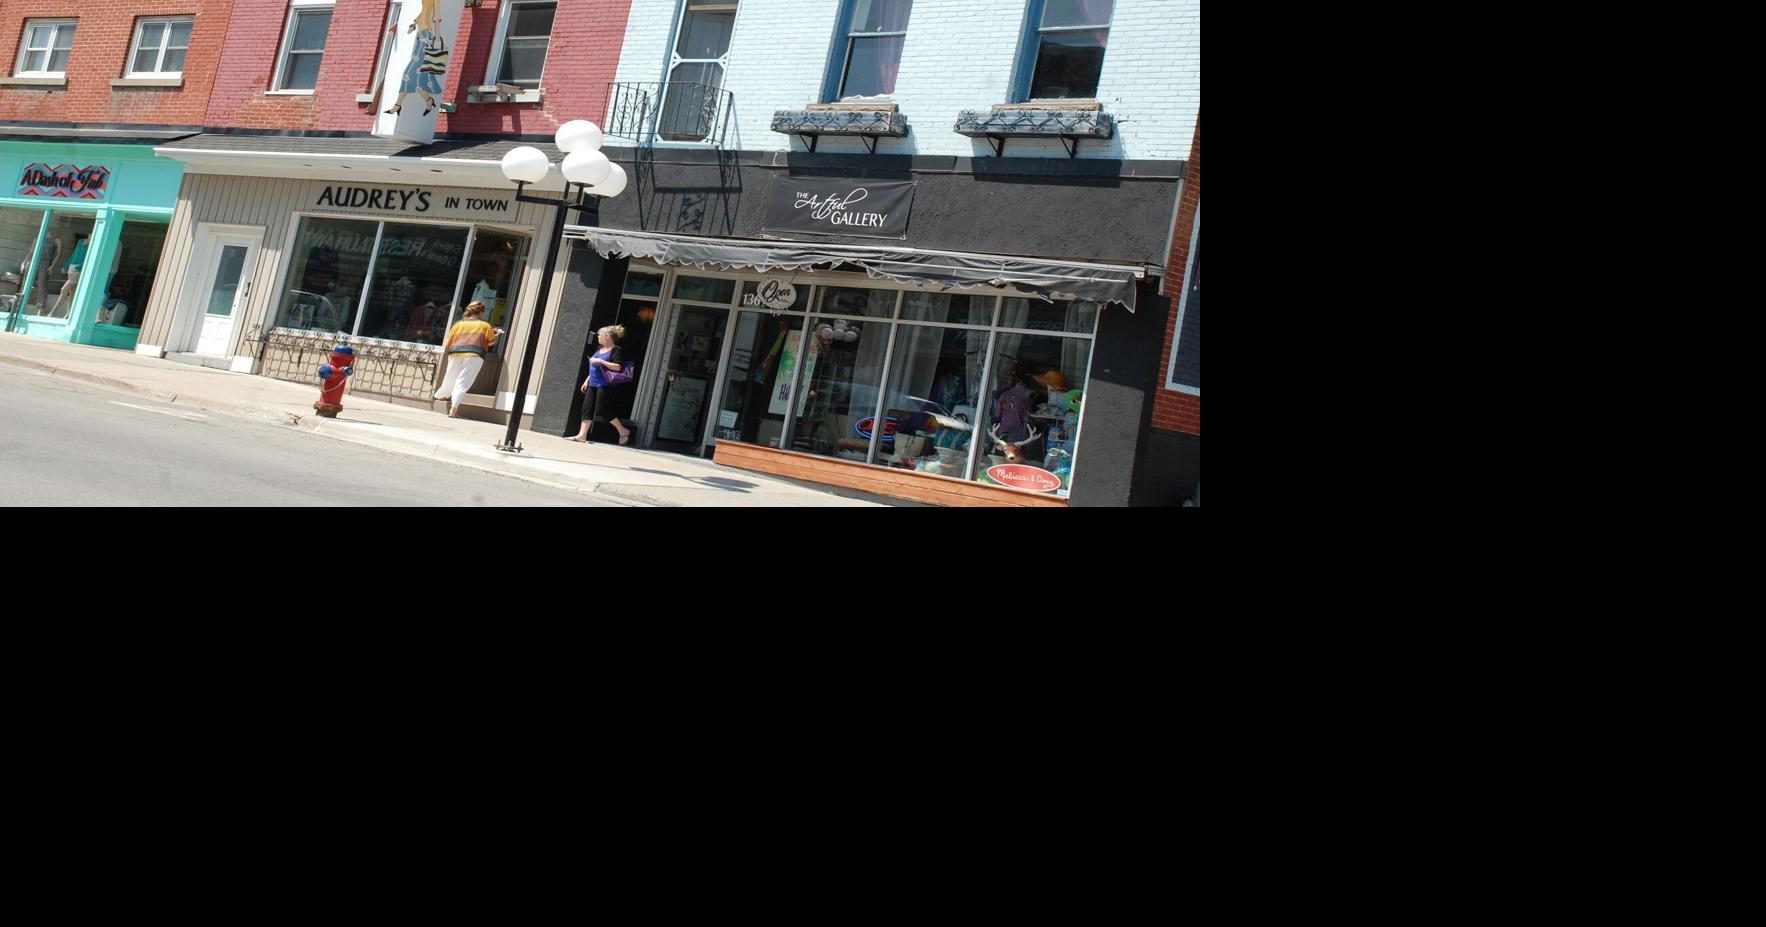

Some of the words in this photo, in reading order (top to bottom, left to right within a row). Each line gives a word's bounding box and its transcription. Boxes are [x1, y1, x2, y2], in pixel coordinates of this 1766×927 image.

[316, 186, 431, 212] AUDREY'S
[444, 197, 459, 209] IN
[465, 198, 508, 212] TOWN
[794, 187, 868, 220] Artful
[796, 191, 809, 199] THE
[831, 211, 888, 227] GALLERY
[761, 279, 791, 302] Open
